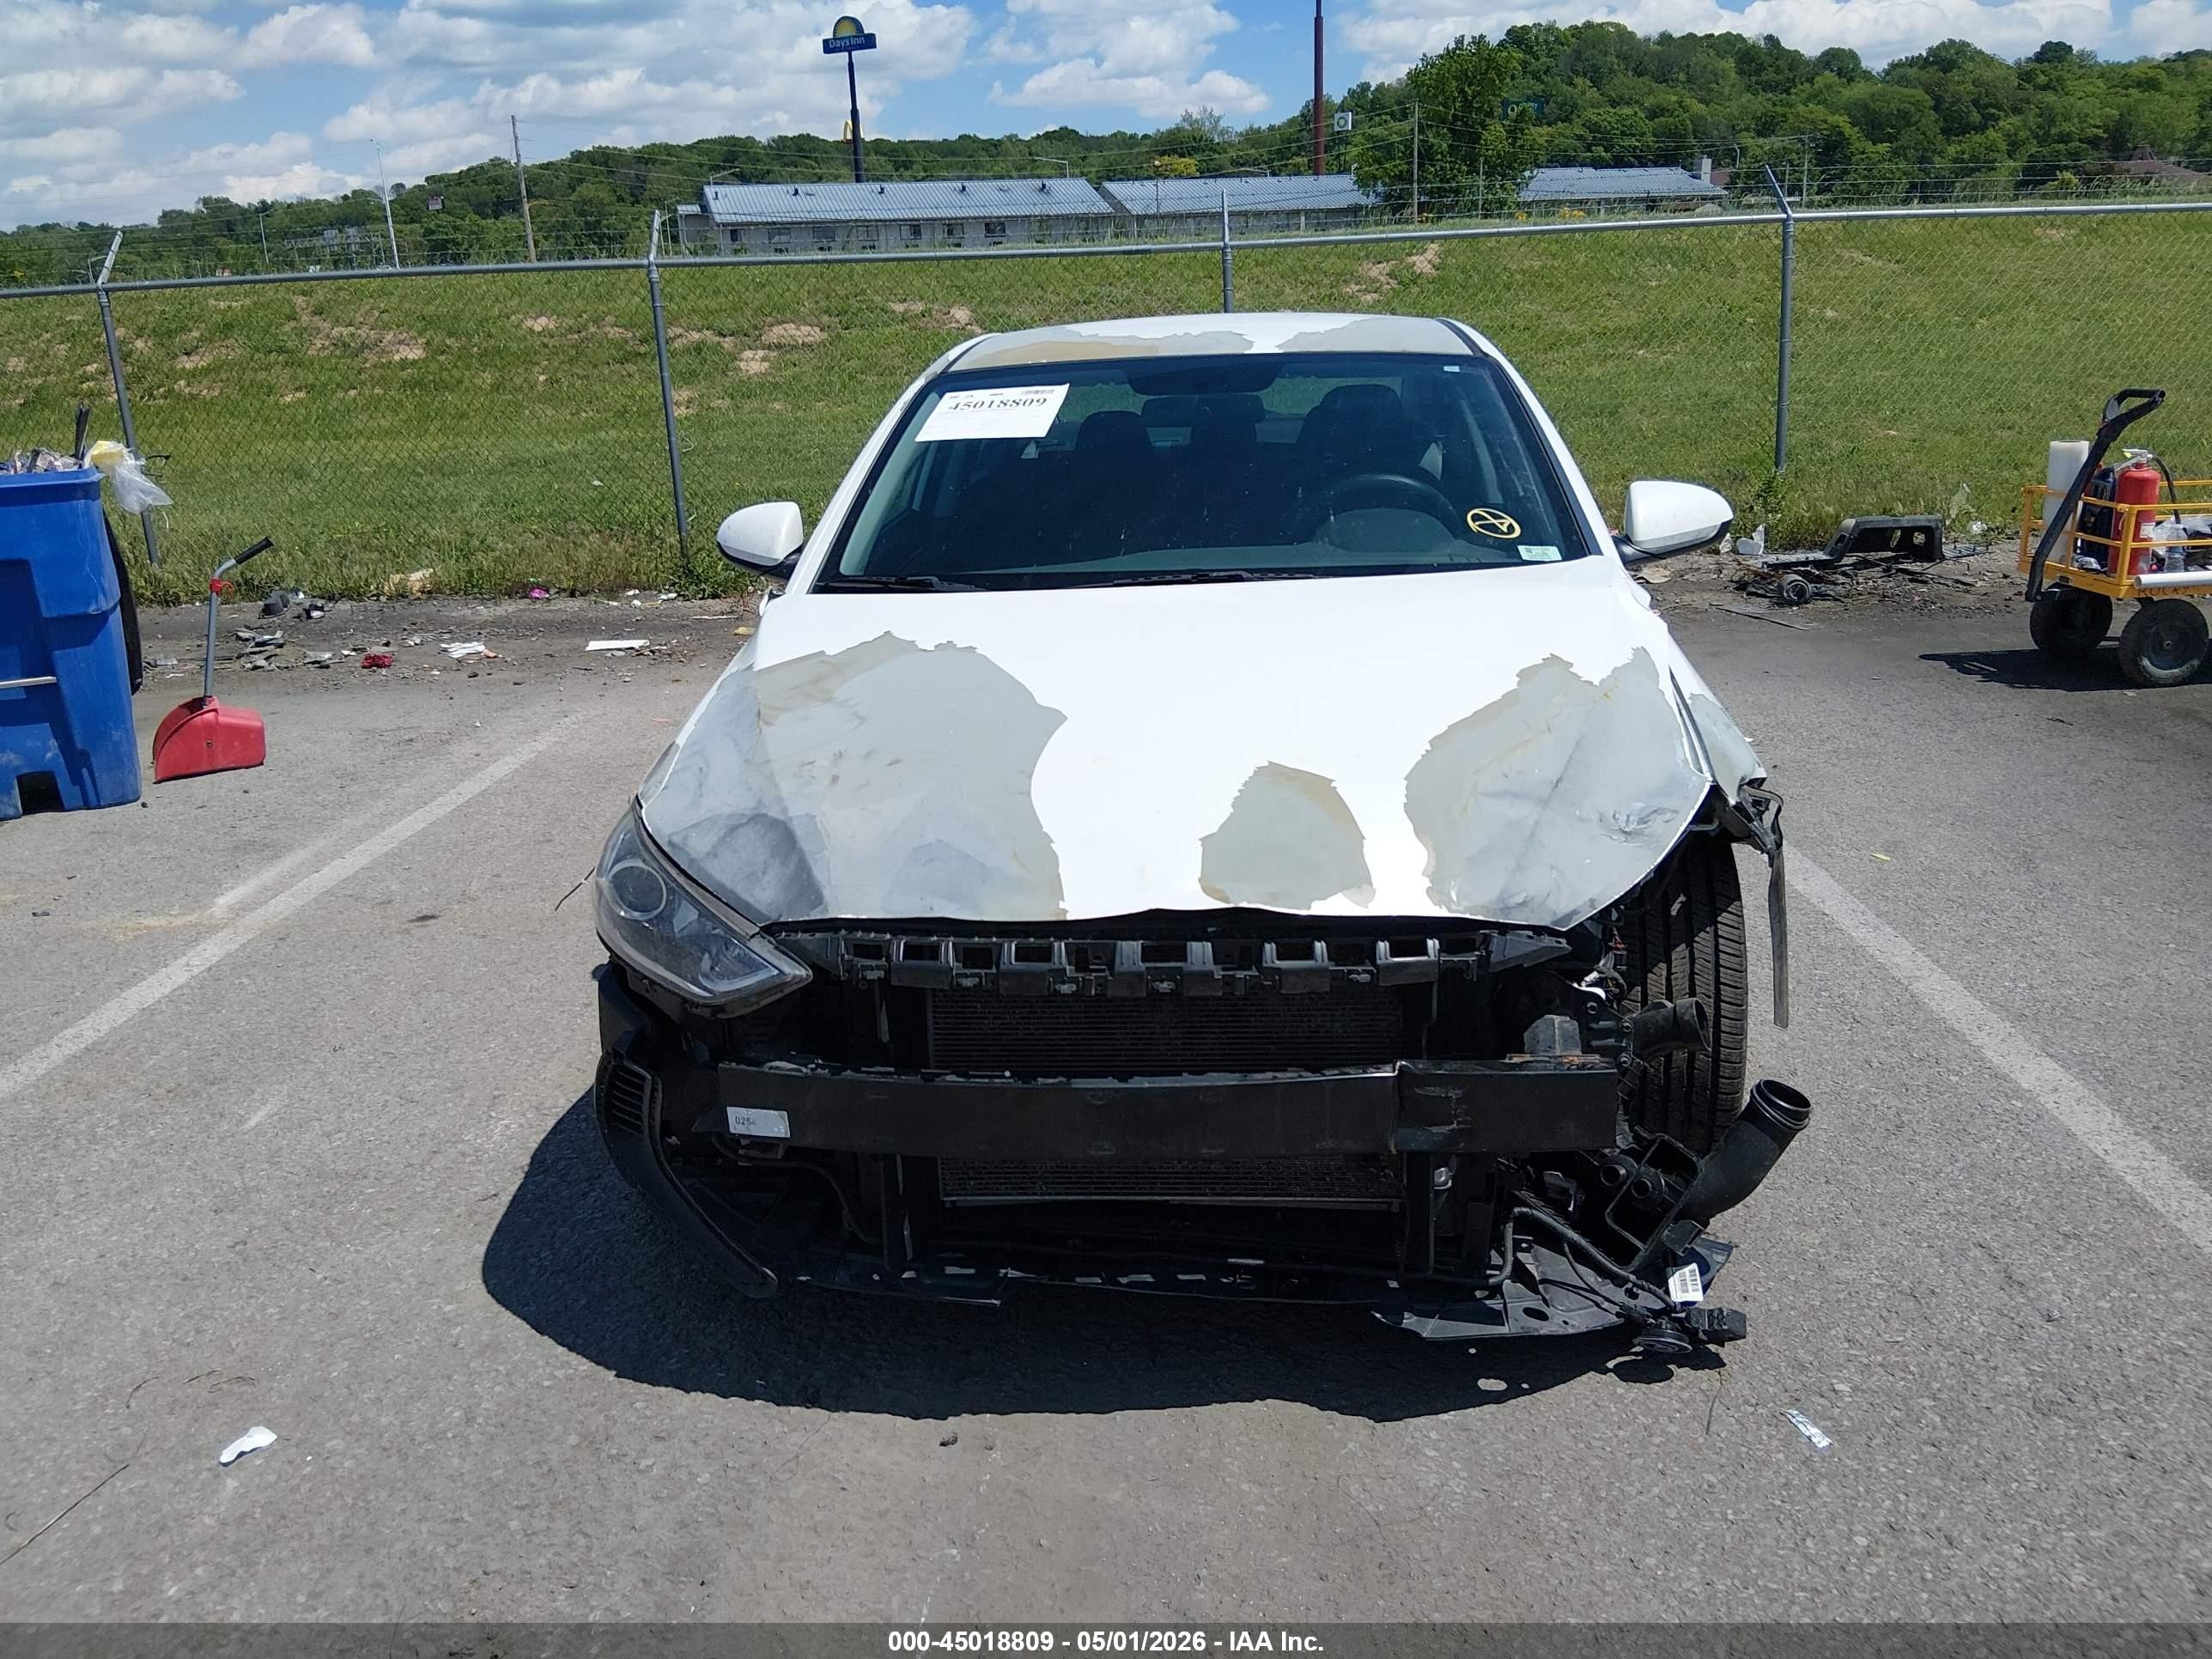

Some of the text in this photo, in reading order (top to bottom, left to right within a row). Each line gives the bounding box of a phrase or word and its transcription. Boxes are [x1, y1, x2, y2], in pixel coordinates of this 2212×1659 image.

[829, 39, 850, 48] Days
[851, 36, 866, 46] Inn
[948, 398, 1048, 410] 45018809
